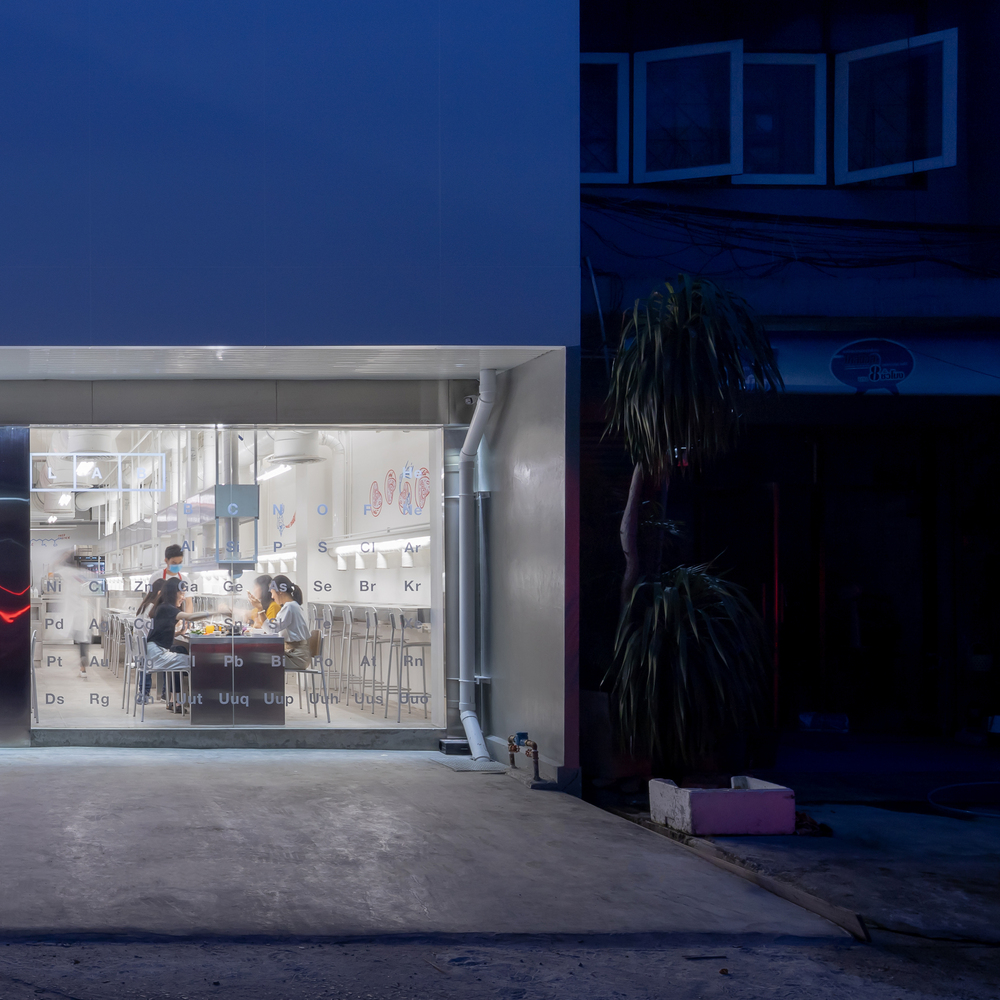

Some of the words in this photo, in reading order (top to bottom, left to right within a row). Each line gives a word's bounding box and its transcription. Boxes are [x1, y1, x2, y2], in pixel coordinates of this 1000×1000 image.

[869, 365, 881, 382] 8
[402, 467, 421, 478] He
[227, 504, 238, 516] C
[272, 504, 282, 515] N
[316, 504, 328, 515] O
[363, 504, 371, 515] F
[402, 504, 422, 516] Ne
[180, 541, 194, 552] Al
[226, 541, 240, 552] Si
[274, 542, 282, 552] P
[318, 542, 328, 552] S
[360, 542, 375, 553] Cl
[404, 542, 421, 552] Ar
[47, 581, 62, 592] Ni
[134, 581, 153, 592] Zn
[178, 580, 198, 592] Ga
[224, 580, 243, 592] Ge
[268, 580, 288, 592] As
[313, 580, 332, 592] Se
[360, 581, 376, 592] Br
[404, 581, 422, 592] Kr
[45, 618, 64, 630] Pd
[134, 618, 154, 630] Cd
[314, 618, 331, 630] Te
[47, 656, 62, 667] Pt
[89, 656, 108, 668] Au
[224, 656, 244, 667] Pb
[272, 656, 286, 667] Bi
[360, 656, 376, 667] At
[404, 656, 423, 667] Rn
[45, 694, 64, 704] Ds
[90, 694, 110, 707] Rg
[176, 693, 202, 704] Uut
[219, 693, 249, 707] Uuq
[264, 693, 294, 707] Uup
[309, 694, 338, 704] Uuh
[354, 694, 384, 704] Uus
